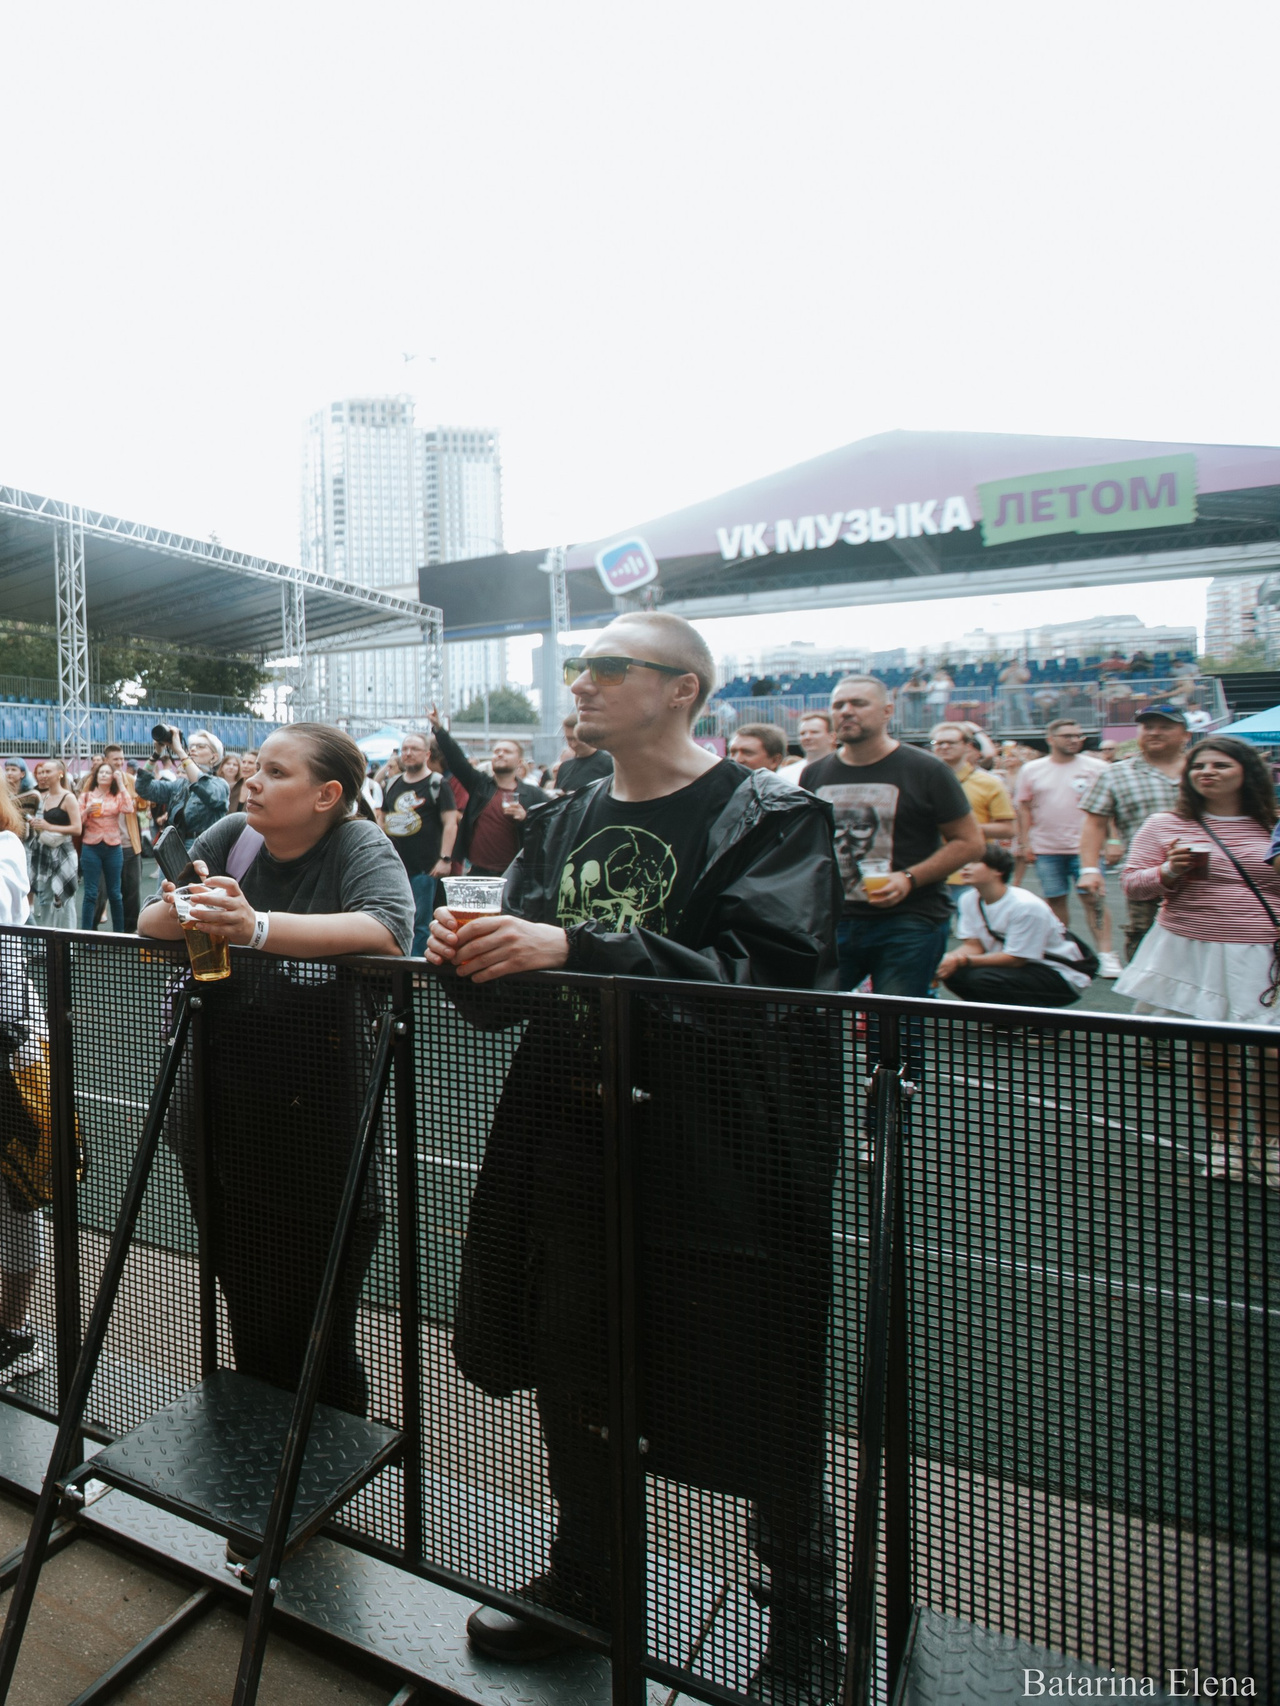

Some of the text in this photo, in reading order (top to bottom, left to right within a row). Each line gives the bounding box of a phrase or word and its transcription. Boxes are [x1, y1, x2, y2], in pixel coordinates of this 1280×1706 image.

[717, 472, 1177, 560] VK МУЗЫКА ЛЕТОМ
